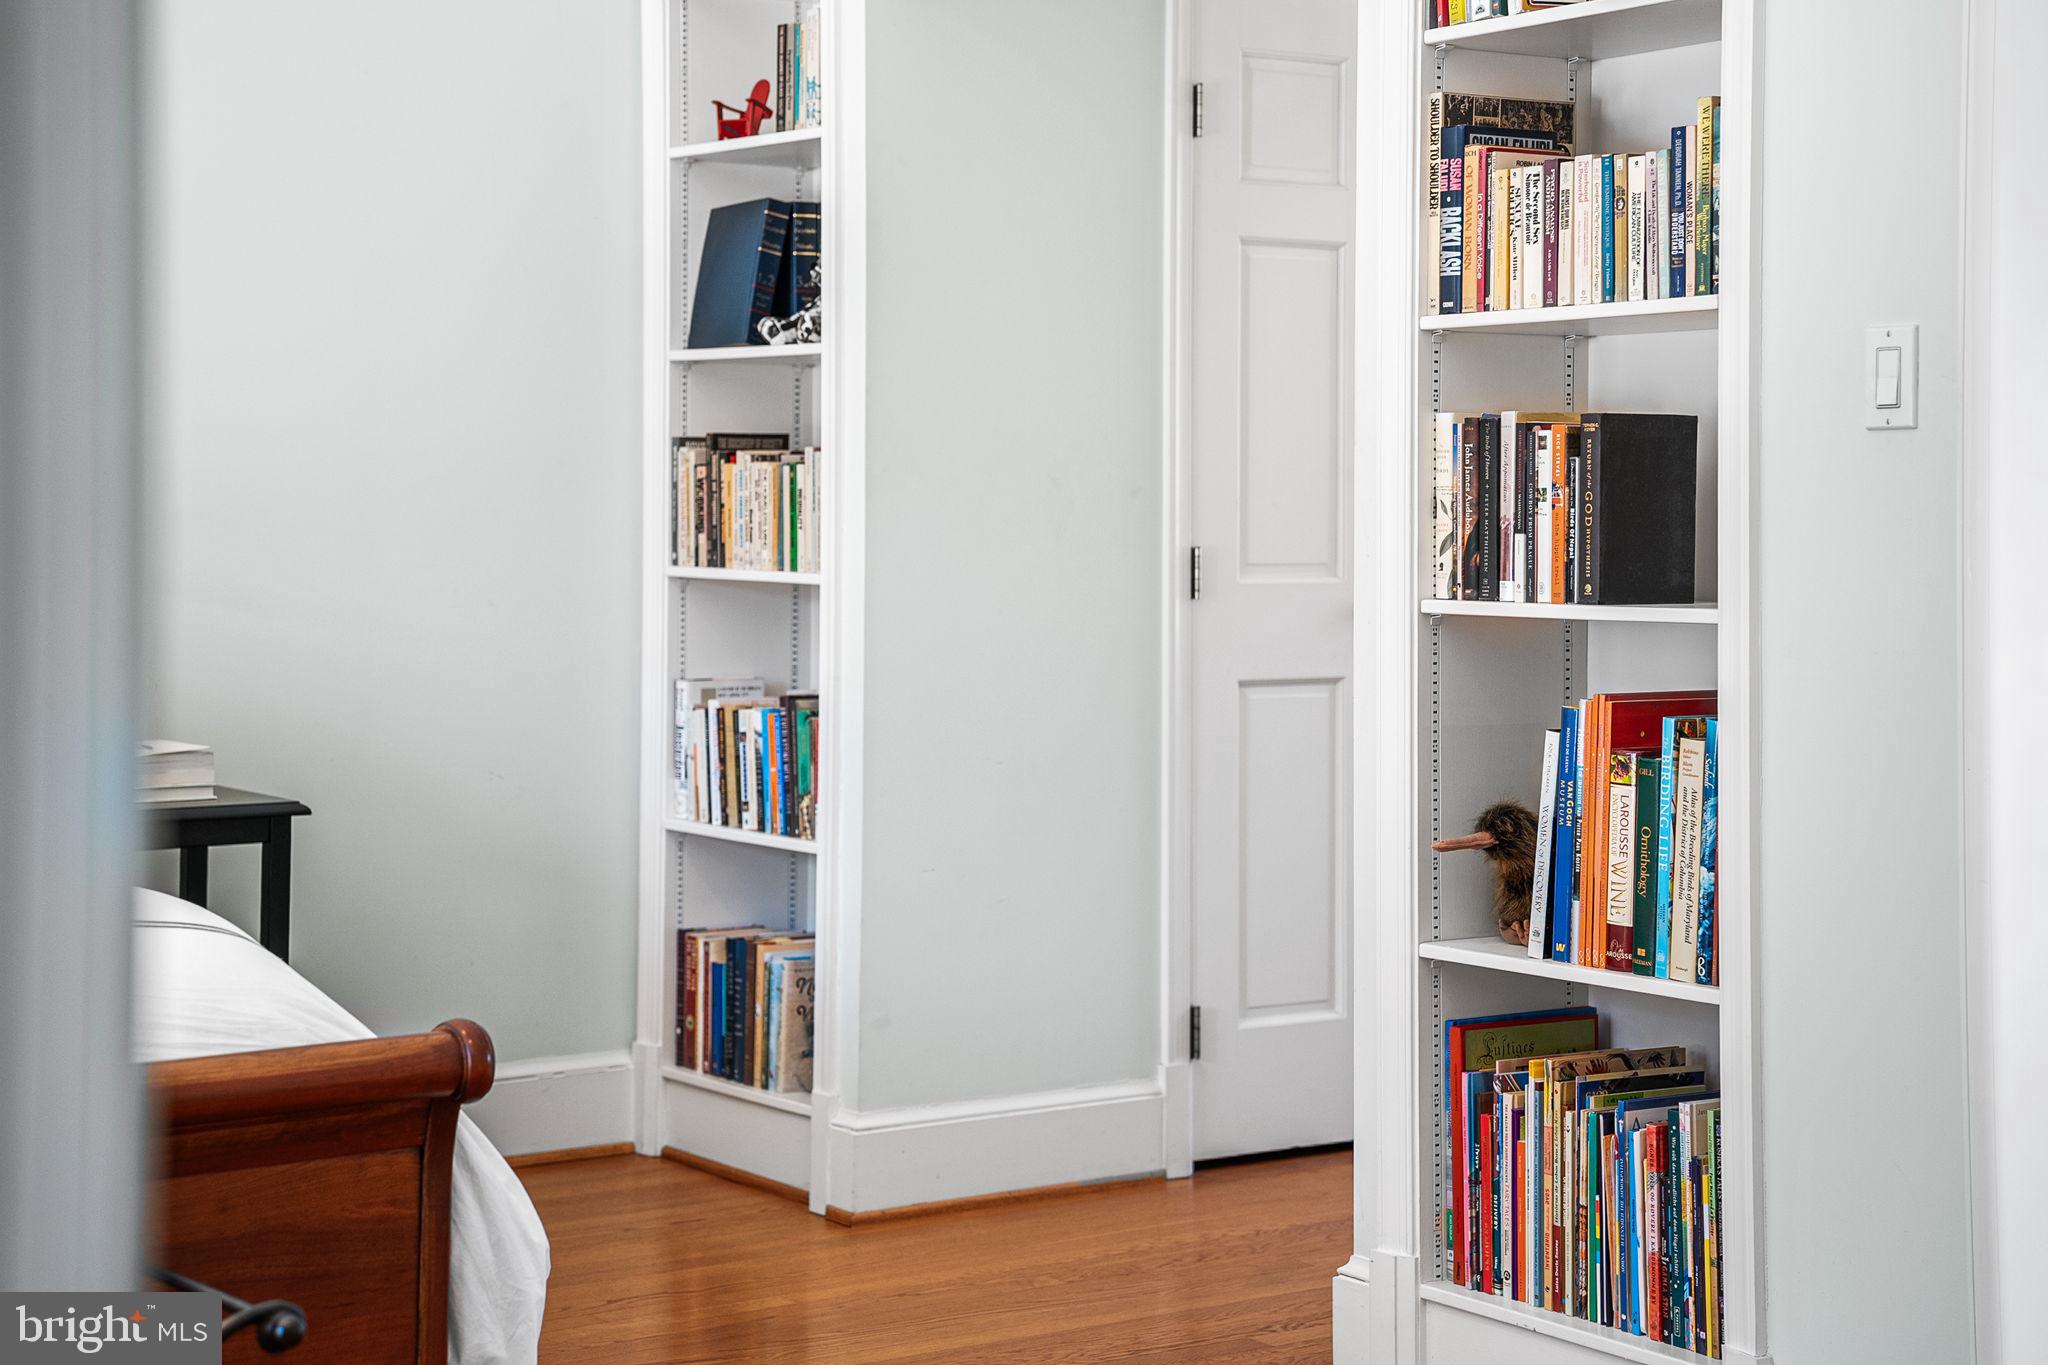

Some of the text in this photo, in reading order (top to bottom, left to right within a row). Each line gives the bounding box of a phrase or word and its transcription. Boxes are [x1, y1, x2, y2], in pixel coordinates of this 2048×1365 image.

[1429, 98, 1440, 210] SHOULDER TO SHOULDER
[1450, 158, 1462, 190] SUSAN
[1674, 138, 1683, 207] DEBORAH TANNEN, Ph.D.
[1701, 105, 1710, 200] WE WERE THERE
[1464, 165, 1473, 271] OF WOMAN BORN
[1525, 202, 1532, 211] de
[1532, 171, 1540, 245] The Second Sex
[1686, 181, 1694, 245] WOMAN'S PLACE
[1440, 206, 1462, 276] BACKLASH
[1524, 212, 1532, 245] Beauvoir
[1671, 212, 1679, 255] UNDERSTAND
[1700, 204, 1710, 256] Barbara Mayer
[1636, 256, 1642, 266] OF
[1483, 451, 1492, 459] of
[1484, 434, 1492, 450] Birds
[1465, 443, 1473, 534] John James Audubon
[1585, 491, 1593, 527] GOD
[1553, 539, 1561, 563] hippie
[1568, 538, 1576, 559] Nepal
[1569, 528, 1576, 537] Of
[1639, 767, 1654, 777] GILL
[1659, 754, 1671, 829] BIRDING
[1682, 787, 1690, 800] and
[1558, 780, 1566, 826] MUSEUM
[1565, 781, 1575, 828] VAN GOGH
[1681, 801, 1689, 812] the
[1540, 805, 1550, 847] WOMEN
[1610, 794, 1619, 858] ENCYCLOPEDIA OF
[1619, 795, 1630, 858] LAROUSSE
[1680, 813, 1689, 843] District
[1638, 826, 1653, 899] Ornithology
[1658, 835, 1670, 873] LIFE
[1682, 788, 1698, 945] Atlas of the Breeding Birds of Maryland
[1534, 860, 1546, 914] DISCOVERY
[1610, 860, 1629, 917] WINE
[1678, 858, 1687, 901] Columbia
[1650, 1192, 1656, 1203] OG
[1651, 1295, 1657, 1305] BY
